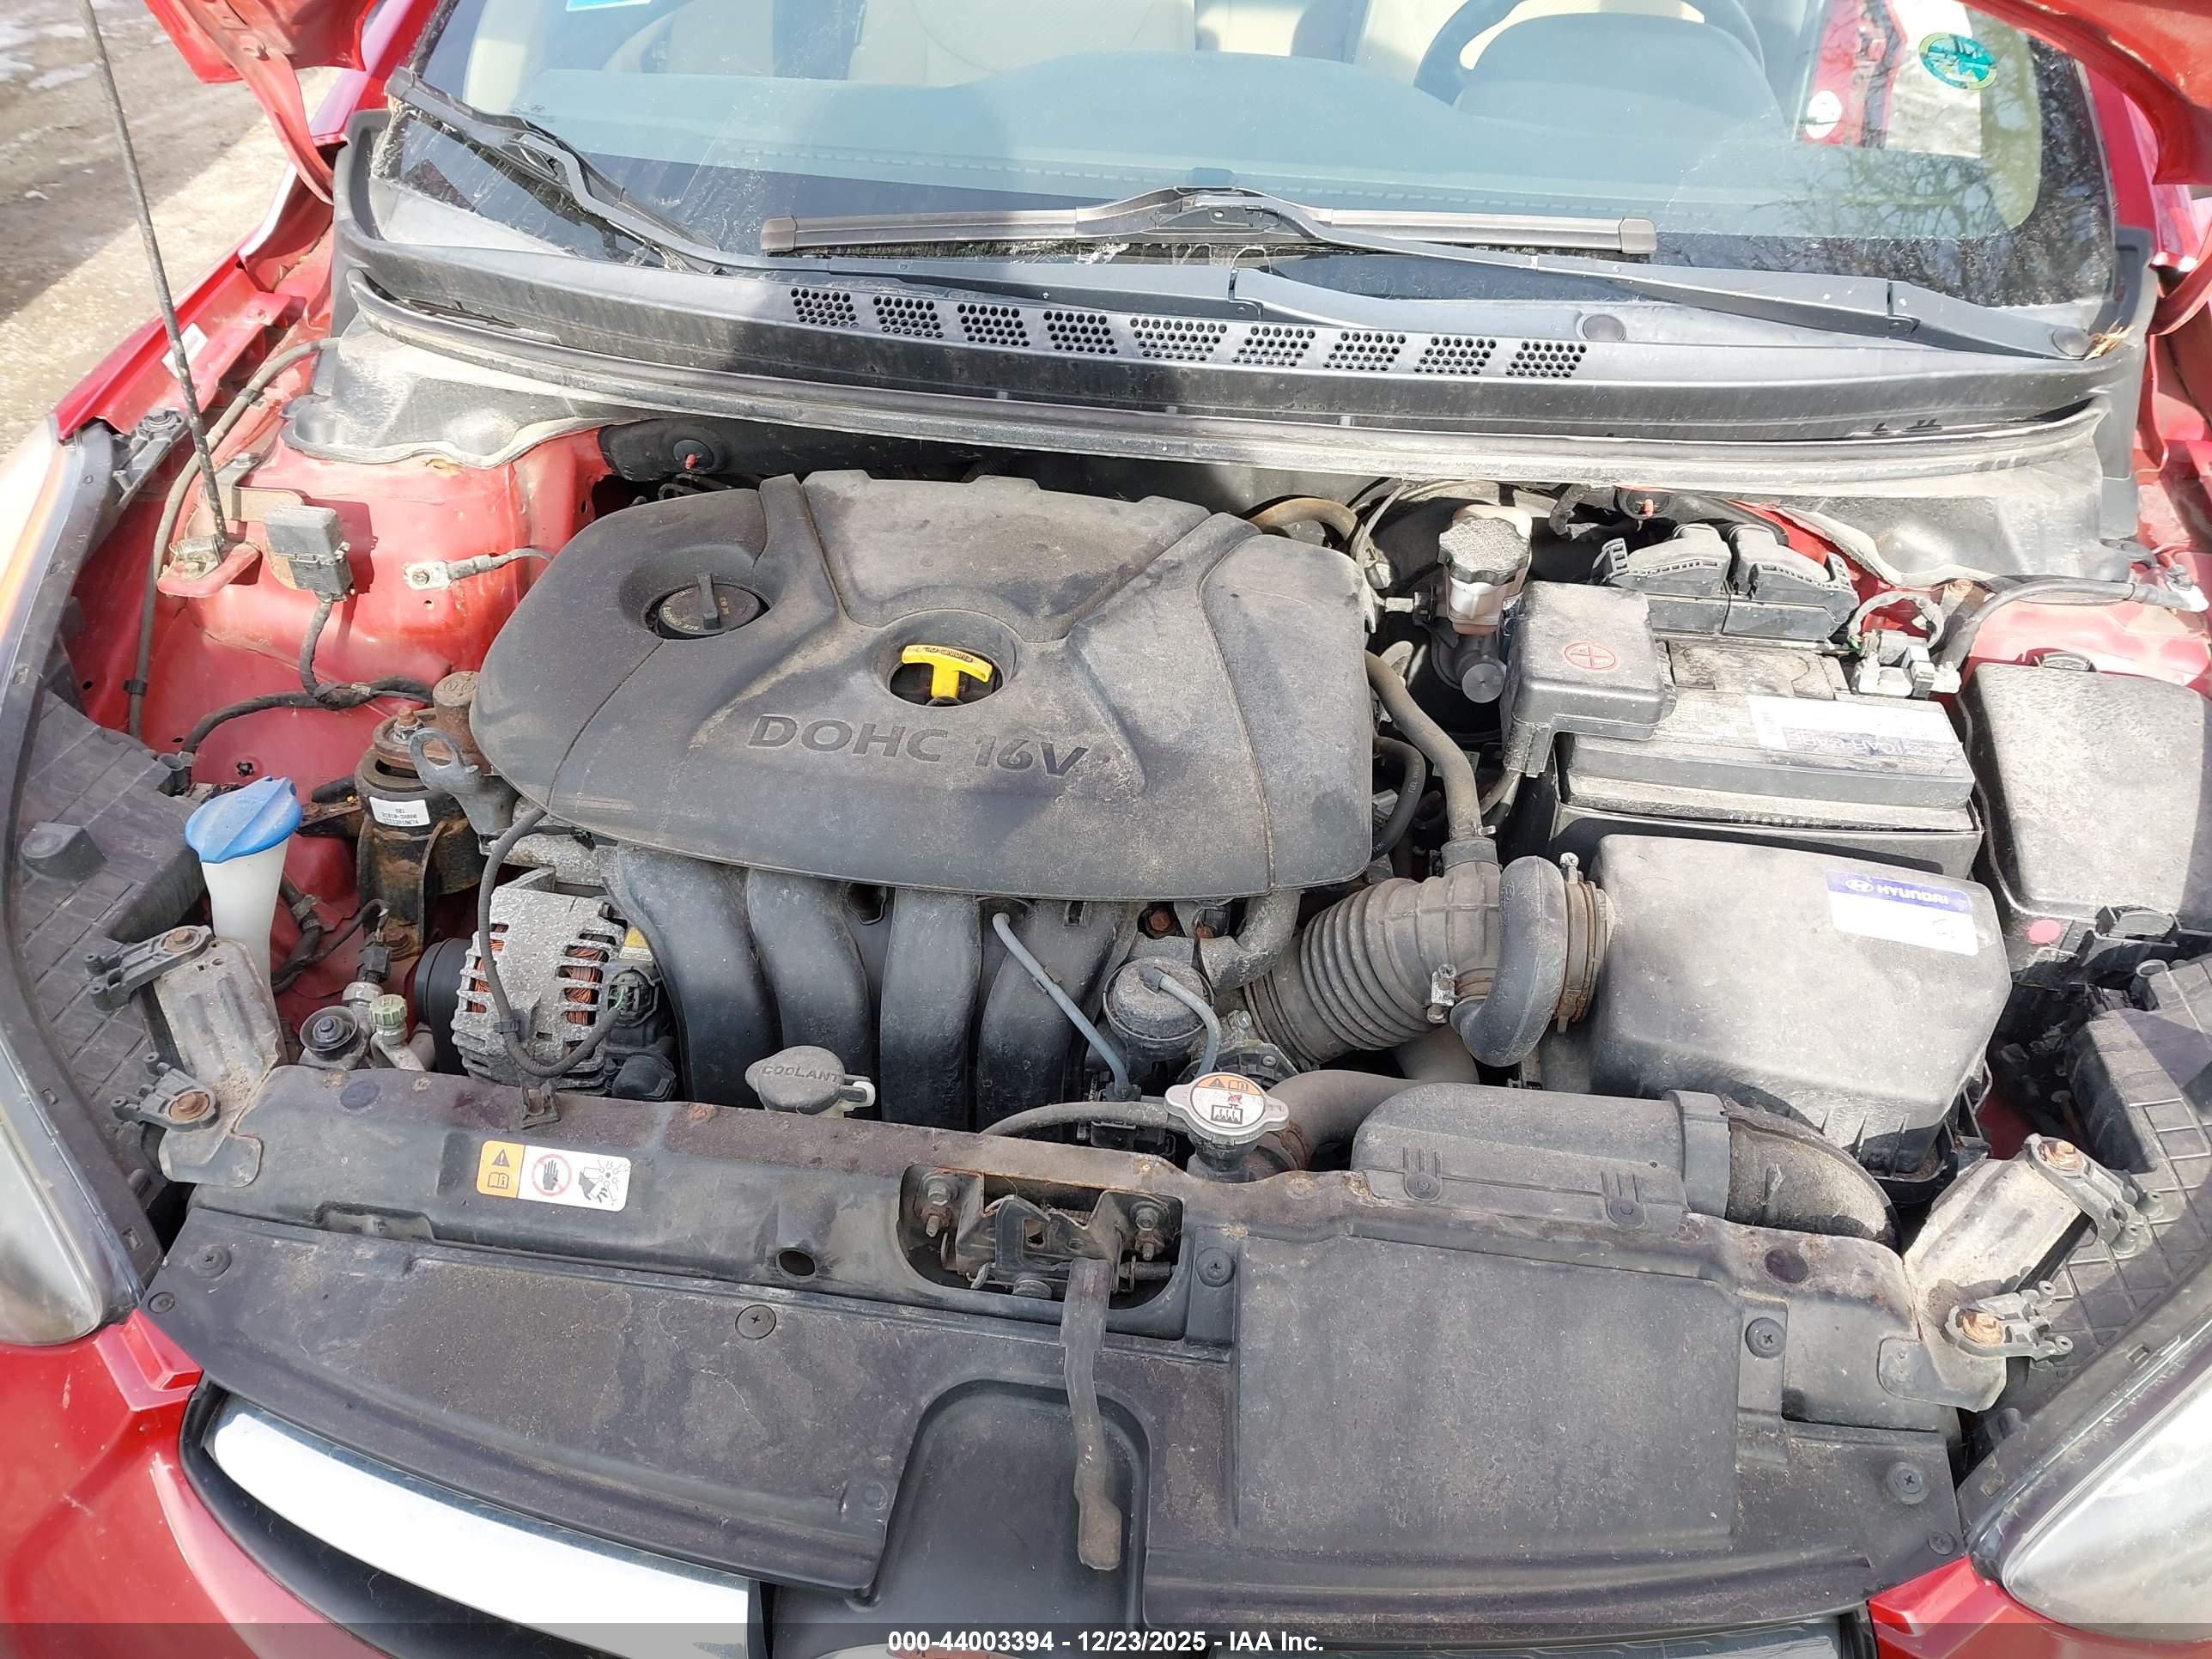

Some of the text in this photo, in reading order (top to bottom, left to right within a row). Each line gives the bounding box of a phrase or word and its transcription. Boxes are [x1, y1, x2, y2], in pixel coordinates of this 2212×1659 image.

[747, 714, 1090, 777] DOHC 16V
[1876, 884, 1950, 905] HYUNDAI
[762, 1065, 841, 1082] COOLANT
